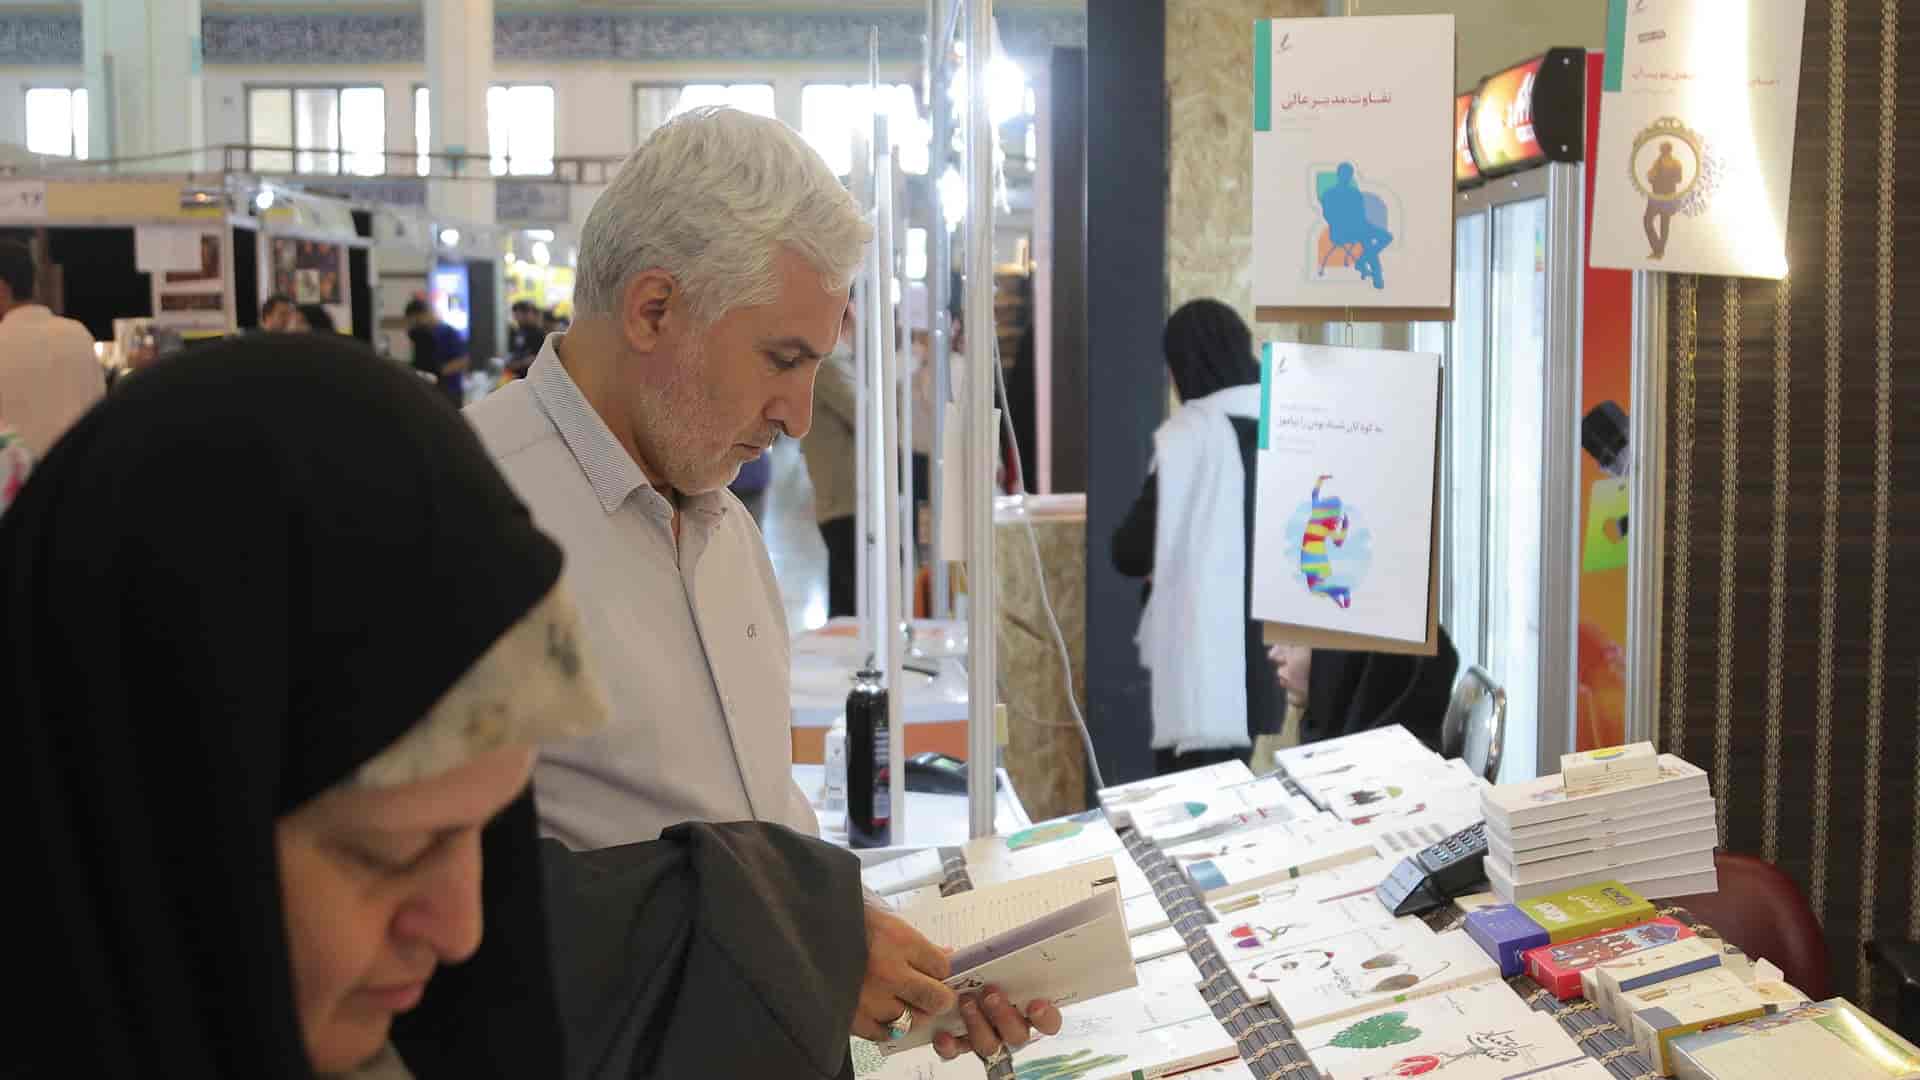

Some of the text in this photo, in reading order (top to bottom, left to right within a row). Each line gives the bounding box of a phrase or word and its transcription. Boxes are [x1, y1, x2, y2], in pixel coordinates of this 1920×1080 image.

[1280, 90, 1392, 111] تفاوت مدیر عالی
